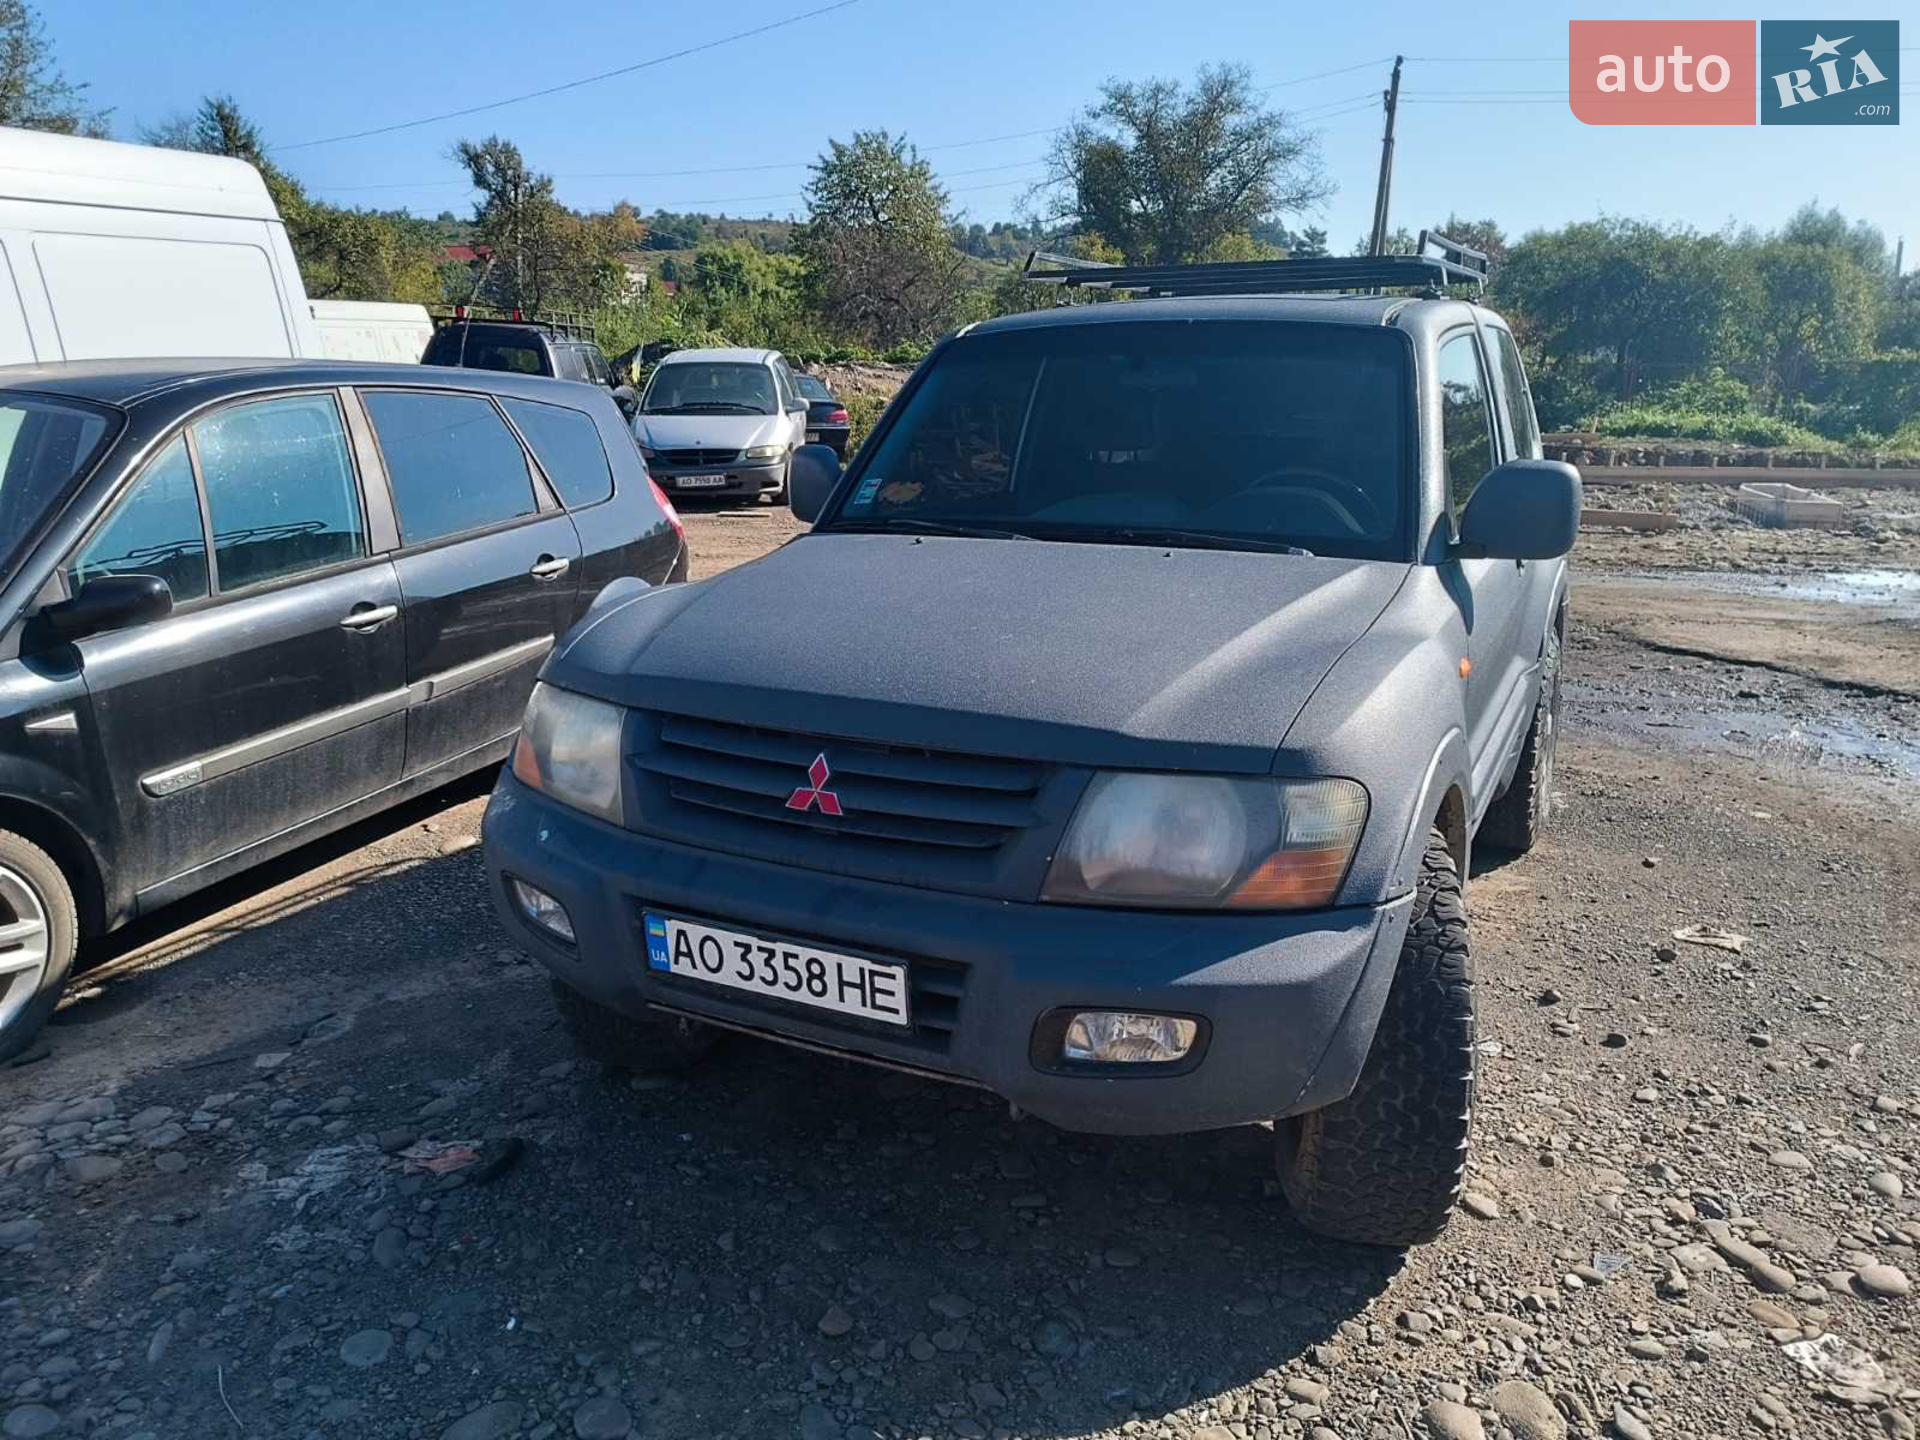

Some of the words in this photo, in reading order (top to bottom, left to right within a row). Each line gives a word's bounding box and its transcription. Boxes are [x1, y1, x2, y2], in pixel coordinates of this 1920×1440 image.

[652, 949, 668, 963] UA
[673, 929, 725, 974] AO
[733, 940, 828, 998] 3358
[836, 962, 900, 1015] HE
